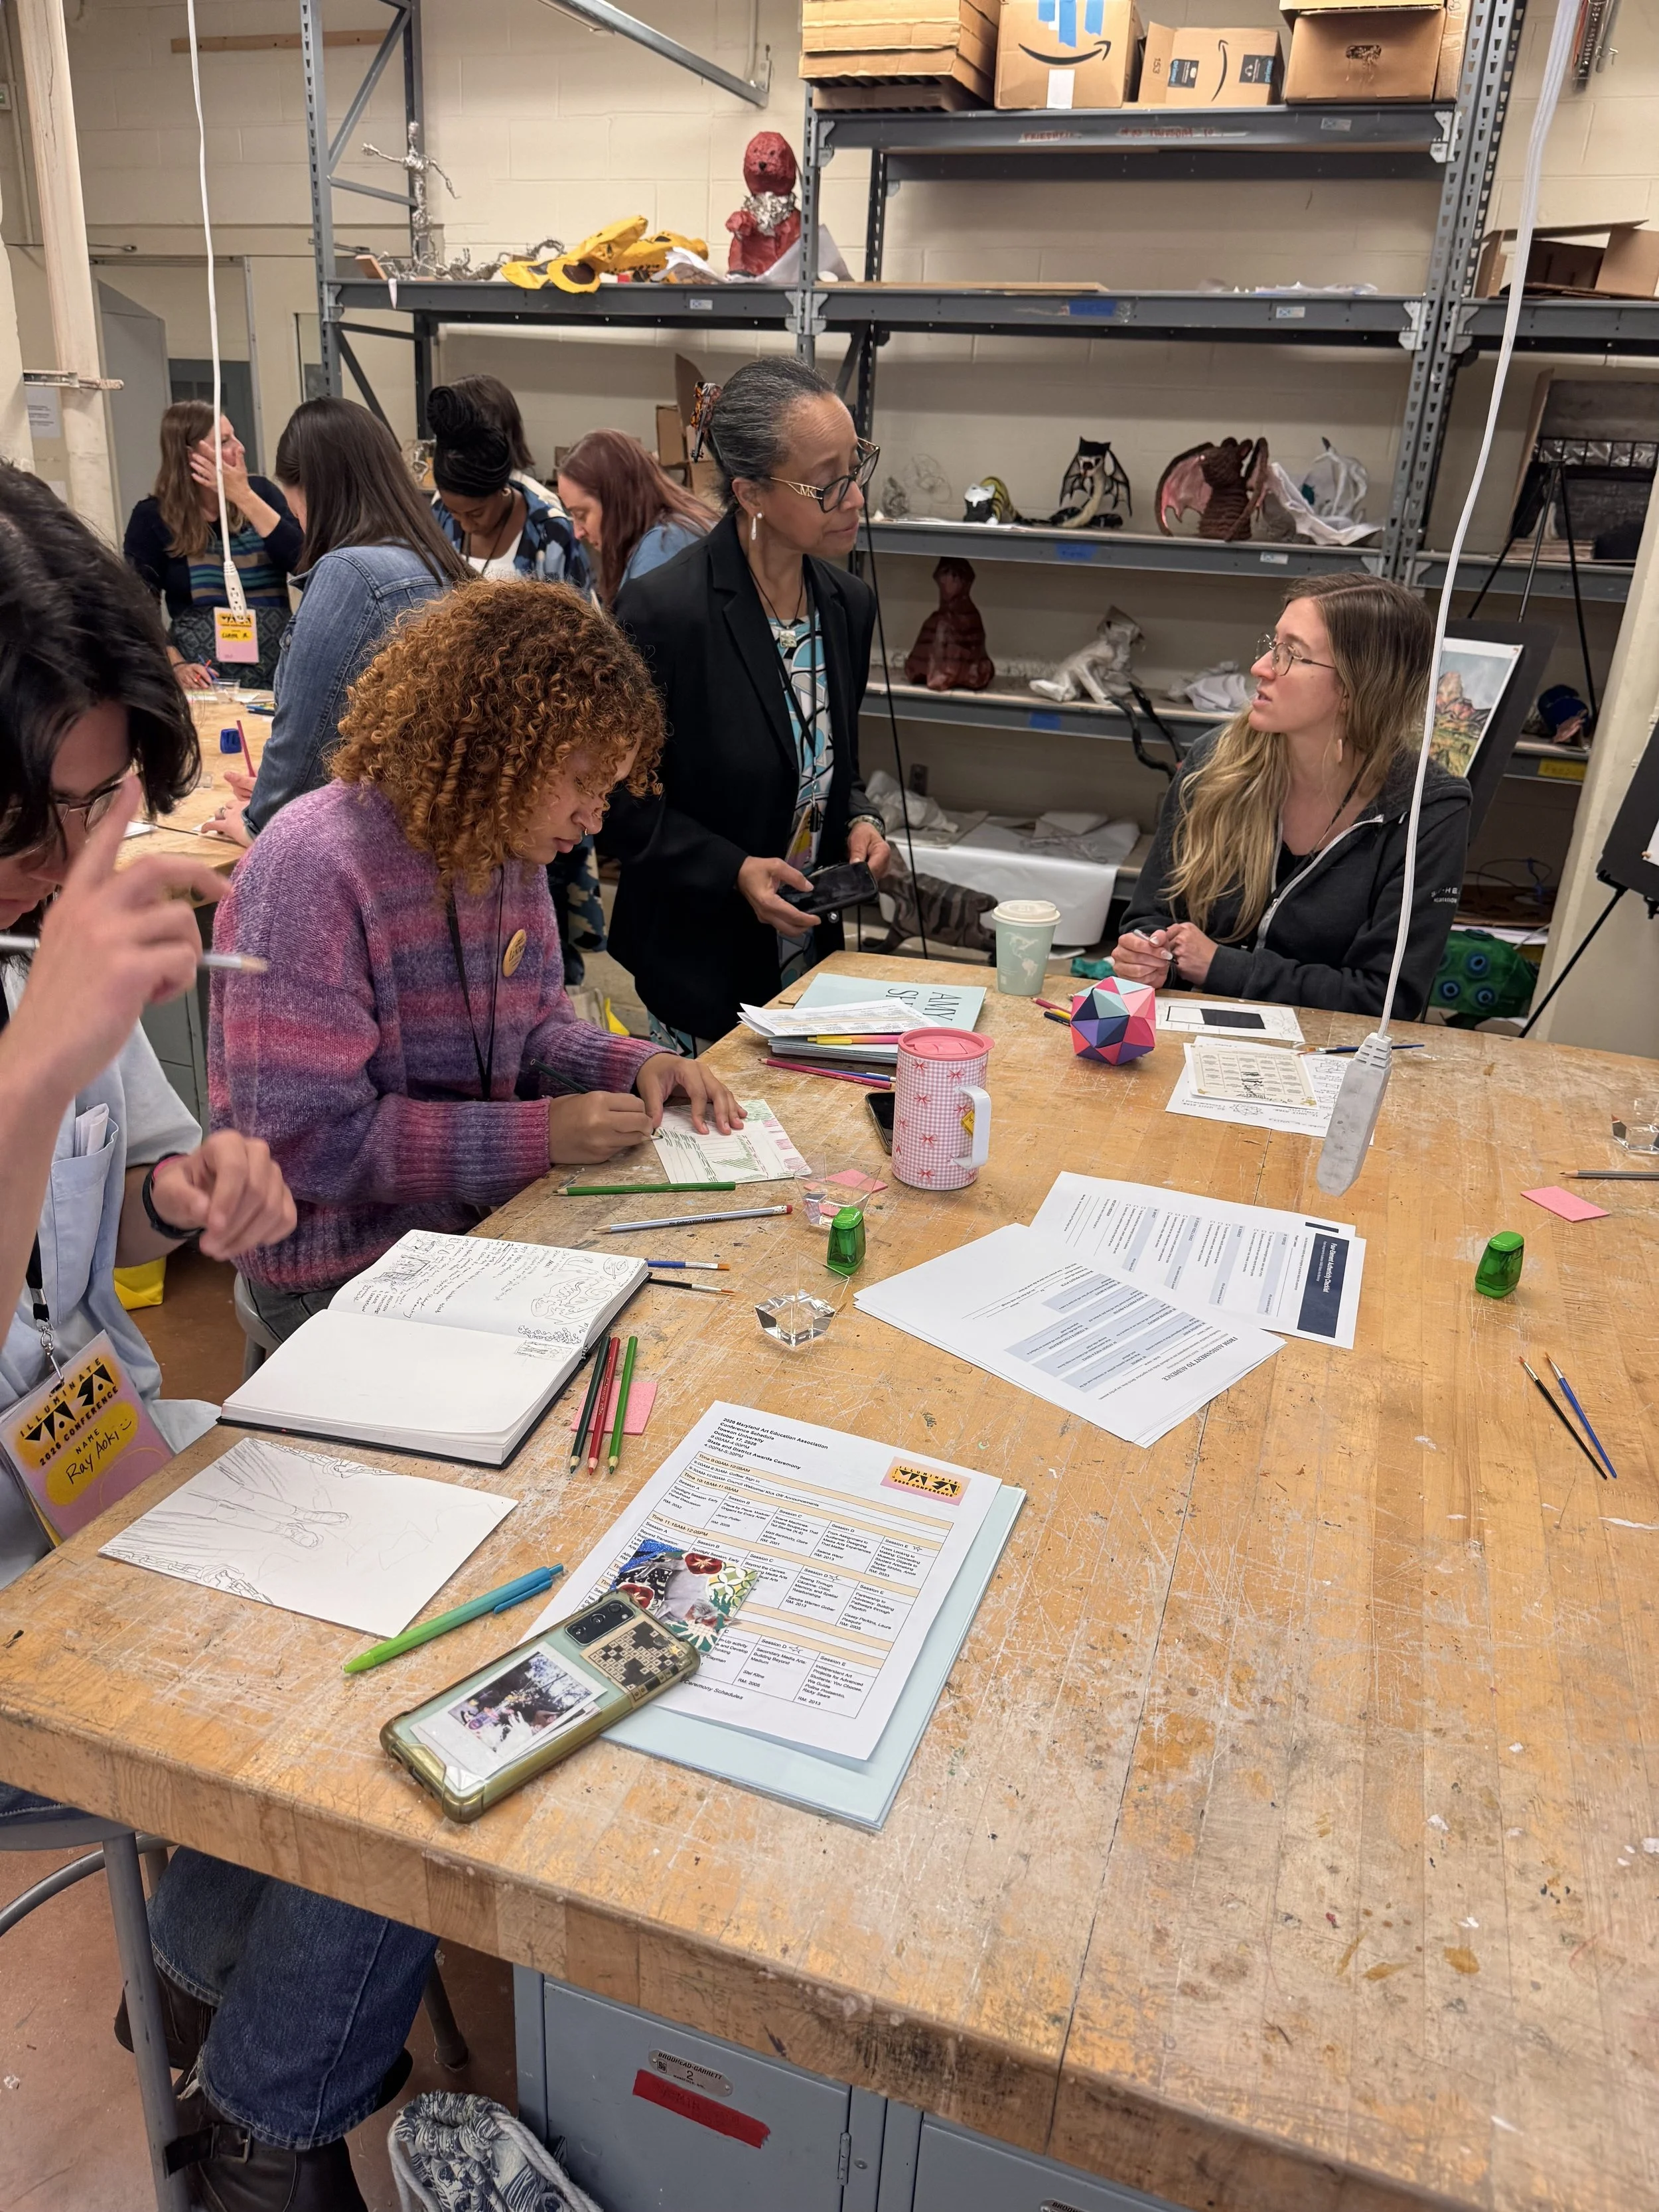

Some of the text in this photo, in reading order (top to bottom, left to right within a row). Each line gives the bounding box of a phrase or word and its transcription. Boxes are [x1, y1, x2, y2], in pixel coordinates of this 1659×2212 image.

[1170, 60, 1179, 82] prime
[922, 992, 962, 1021] AMY
[1323, 1243, 1337, 1293] Four-Element Authenticity Checklist
[1222, 1337, 1238, 1346] FROM
[1193, 1344, 1224, 1363] ASSIGNMENT
[1161, 1366, 1188, 1381] AUDIENCE
[21, 1358, 101, 1438] ILLUMINATE
[40, 1387, 118, 1466] 2026 CONFERENCE
[720, 1422, 774, 1440] Conference Schedule
[76, 1428, 100, 1454] NAME
[714, 1431, 735, 1439] October
[717, 1426, 764, 1443] Towson University
[736, 1422, 760, 1431] Maryland
[770, 1430, 796, 1440] Education
[796, 1438, 828, 1449] Association
[66, 1430, 119, 1485] Ray Aoki
[733, 1447, 752, 1455] District
[774, 1459, 801, 1469] Ceremony
[899, 1465, 958, 1485] ILLUMINATE
[678, 1479, 698, 1488] Session
[912, 1483, 953, 1497] CONFERENCE
[640, 1529, 658, 1538] Beyond
[645, 1522, 666, 1531] Session
[665, 1520, 708, 1536] 11:15AM-12:05PM
[839, 1534, 863, 1543] Assignment
[846, 1540, 867, 1549] Designing
[845, 1544, 871, 1554] Experiences
[855, 1592, 881, 1602] Partnership
[753, 1652, 772, 1660] Building
[757, 1647, 780, 1657] Secondary
[820, 1656, 841, 1664] Session
[813, 1668, 831, 1678] Projects
[839, 1677, 863, 1686] Advanced
[816, 1664, 845, 1676] Independent
[810, 1674, 832, 1683] Students:
[713, 1688, 743, 1700] Schedules
[687, 2070, 693, 2081] 2
